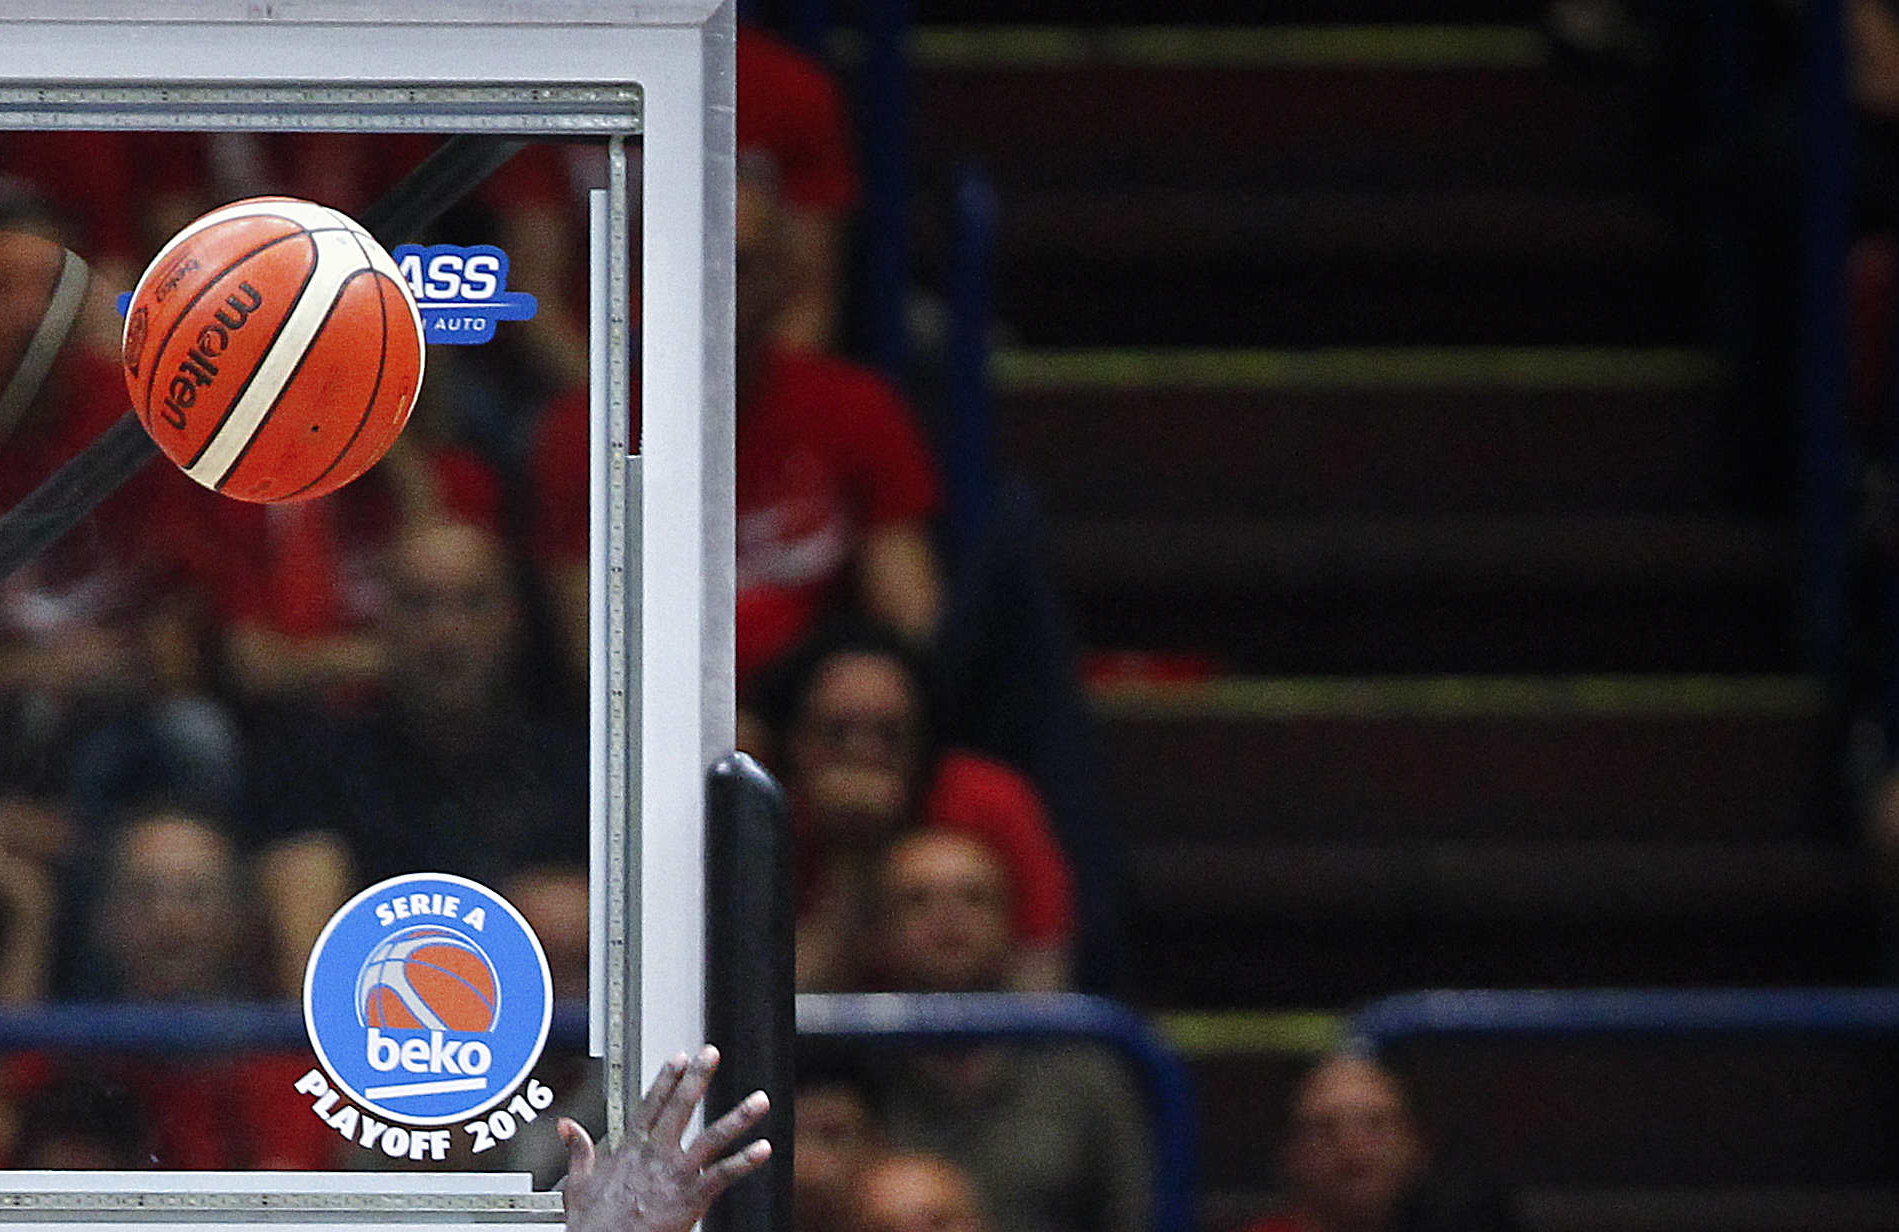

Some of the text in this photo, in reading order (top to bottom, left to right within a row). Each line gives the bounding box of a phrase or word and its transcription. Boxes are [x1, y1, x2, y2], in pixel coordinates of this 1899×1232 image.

[434, 317, 487, 331] AUTO
[160, 281, 263, 430] molten
[375, 893, 486, 931] SERIE A
[367, 1028, 492, 1075] beko
[294, 1068, 555, 1161] PLAYOFF 2016
